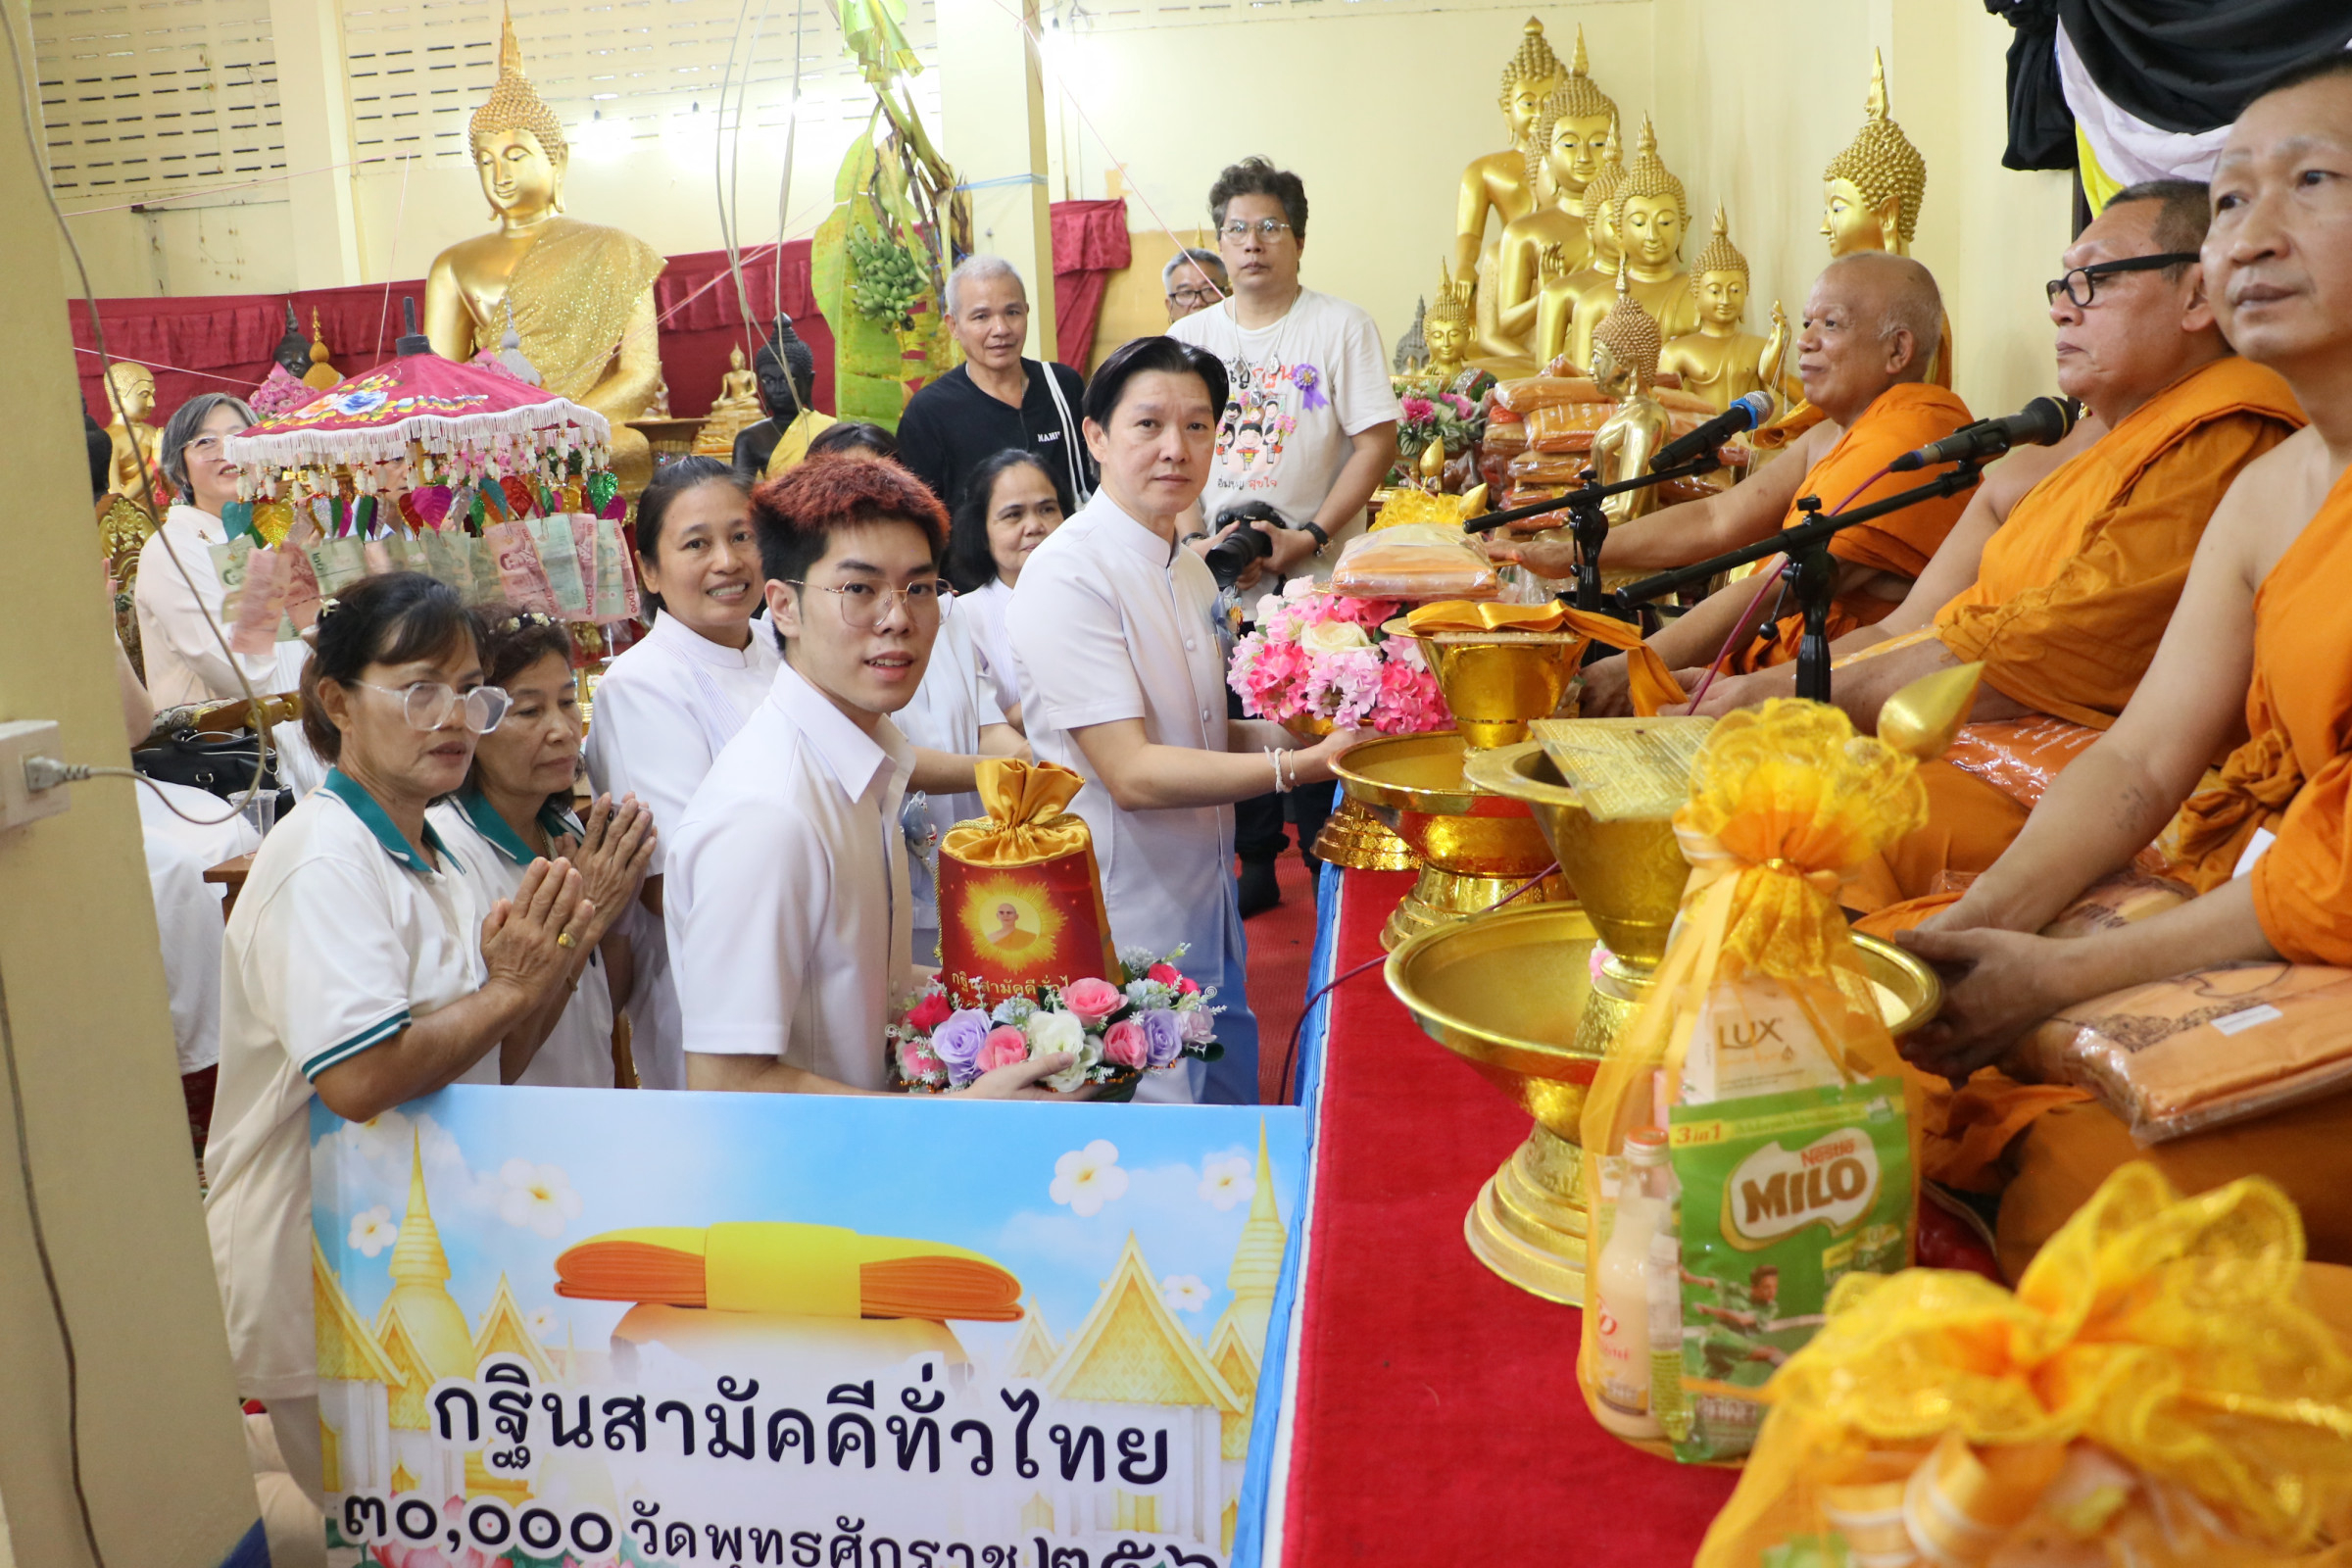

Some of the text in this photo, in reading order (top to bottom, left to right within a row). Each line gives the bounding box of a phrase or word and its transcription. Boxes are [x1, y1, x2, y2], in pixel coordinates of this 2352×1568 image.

[1248, 475, 1278, 491] สุขใจ
[1718, 1017, 1784, 1050] LUX
[1740, 1156, 1868, 1225] MILO
[434, 1362, 1168, 1485] กฐินสามัคคีทั่วไทย
[344, 1494, 613, 1553] ๓๐,๐๐๐
